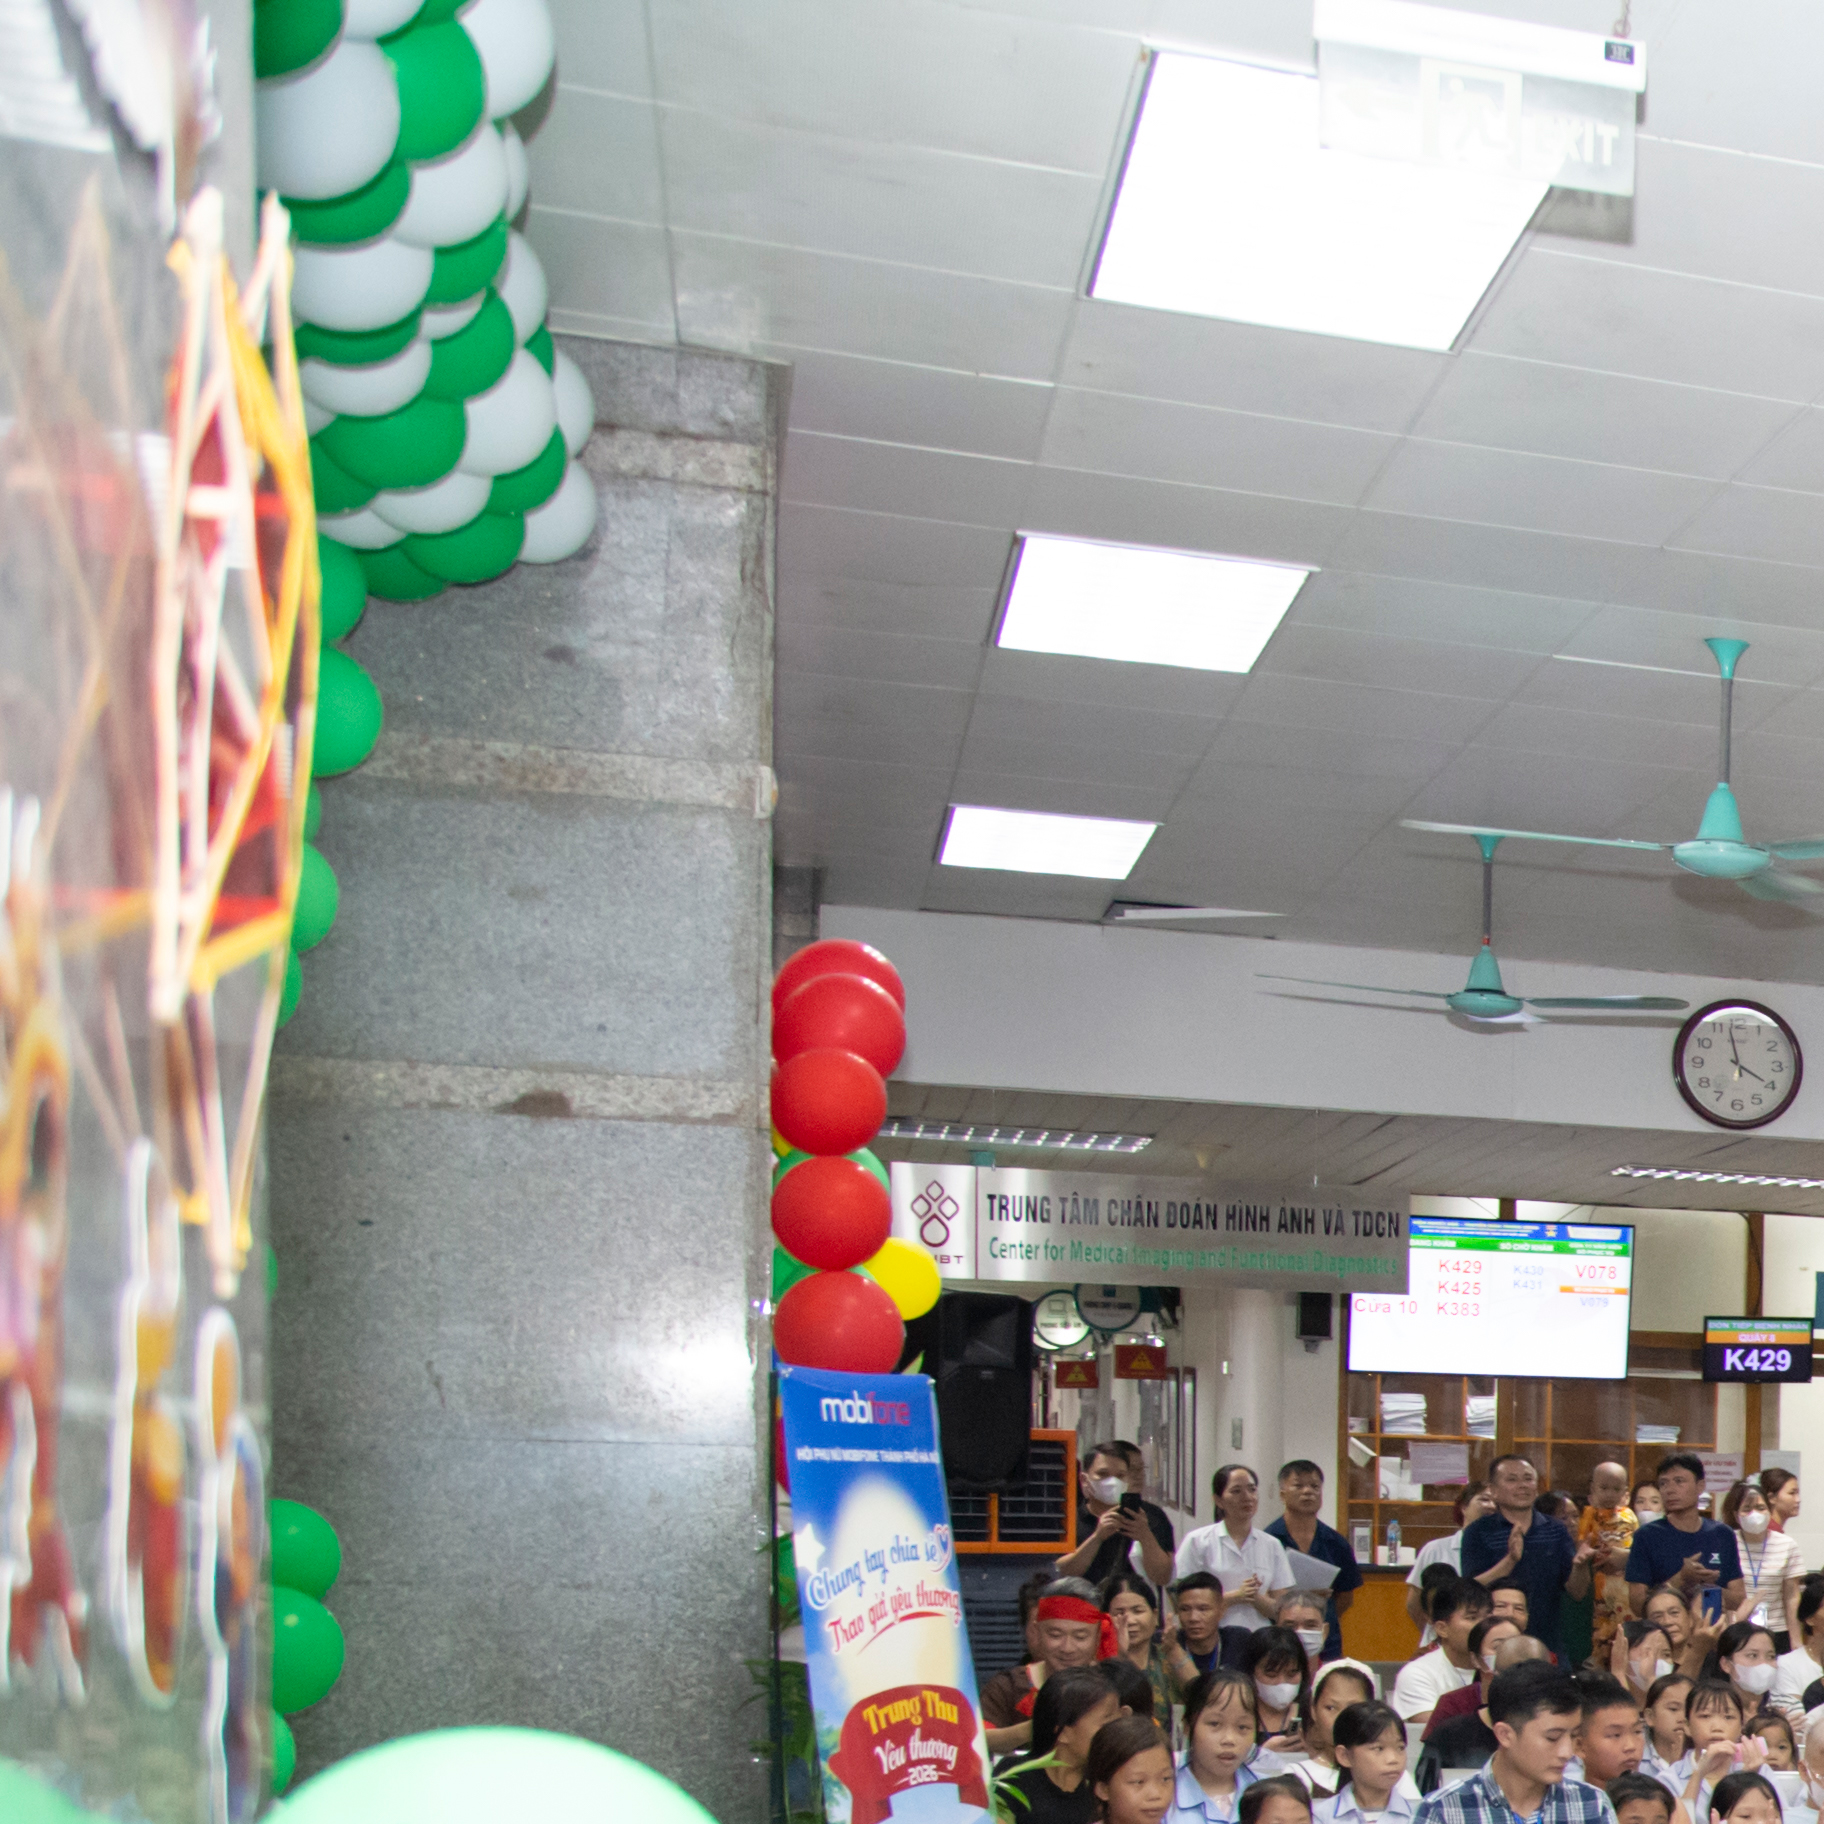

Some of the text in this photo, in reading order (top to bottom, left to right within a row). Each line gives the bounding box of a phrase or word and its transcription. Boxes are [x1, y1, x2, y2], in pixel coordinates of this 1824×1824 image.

[1697, 1037, 1713, 1050] 10
[1766, 1040, 1778, 1052] 2
[1691, 1056, 1705, 1069] 9
[1771, 1060, 1784, 1073] 3
[1698, 1077, 1711, 1089] 8
[1764, 1080, 1777, 1092] 4
[1713, 1090, 1724, 1102] 7
[1750, 1093, 1763, 1106] 5
[1730, 1099, 1745, 1112] 6
[986, 1192, 1051, 1224] TRUNG
[1058, 1191, 1100, 1226] TÂM
[1166, 1196, 1219, 1231] ĐOÁN
[1225, 1200, 1271, 1233] HÌNH
[1277, 1198, 1315, 1235] ẢNH
[1322, 1203, 1346, 1237] VÀ
[1352, 1210, 1400, 1240] TDCN
[988, 1236, 1398, 1279] Center for Medical Imaging and Functional Diagnostics
[1438, 1259, 1482, 1275] K429
[1576, 1264, 1617, 1280] V078
[1437, 1281, 1482, 1296] K425
[1399, 1300, 1418, 1315] 10
[1436, 1302, 1480, 1318] K383
[1724, 1348, 1792, 1372] K429
[820, 1389, 911, 1426] mobifone
[808, 1560, 866, 1607] Chung
[864, 1549, 889, 1584] tay
[890, 1534, 920, 1564] chia
[827, 1615, 865, 1653] Trao
[890, 1586, 913, 1620] yêu
[916, 1579, 961, 1625] thương
[862, 1690, 959, 1735] Trung Thu
[874, 1727, 958, 1775] Yêu thương
